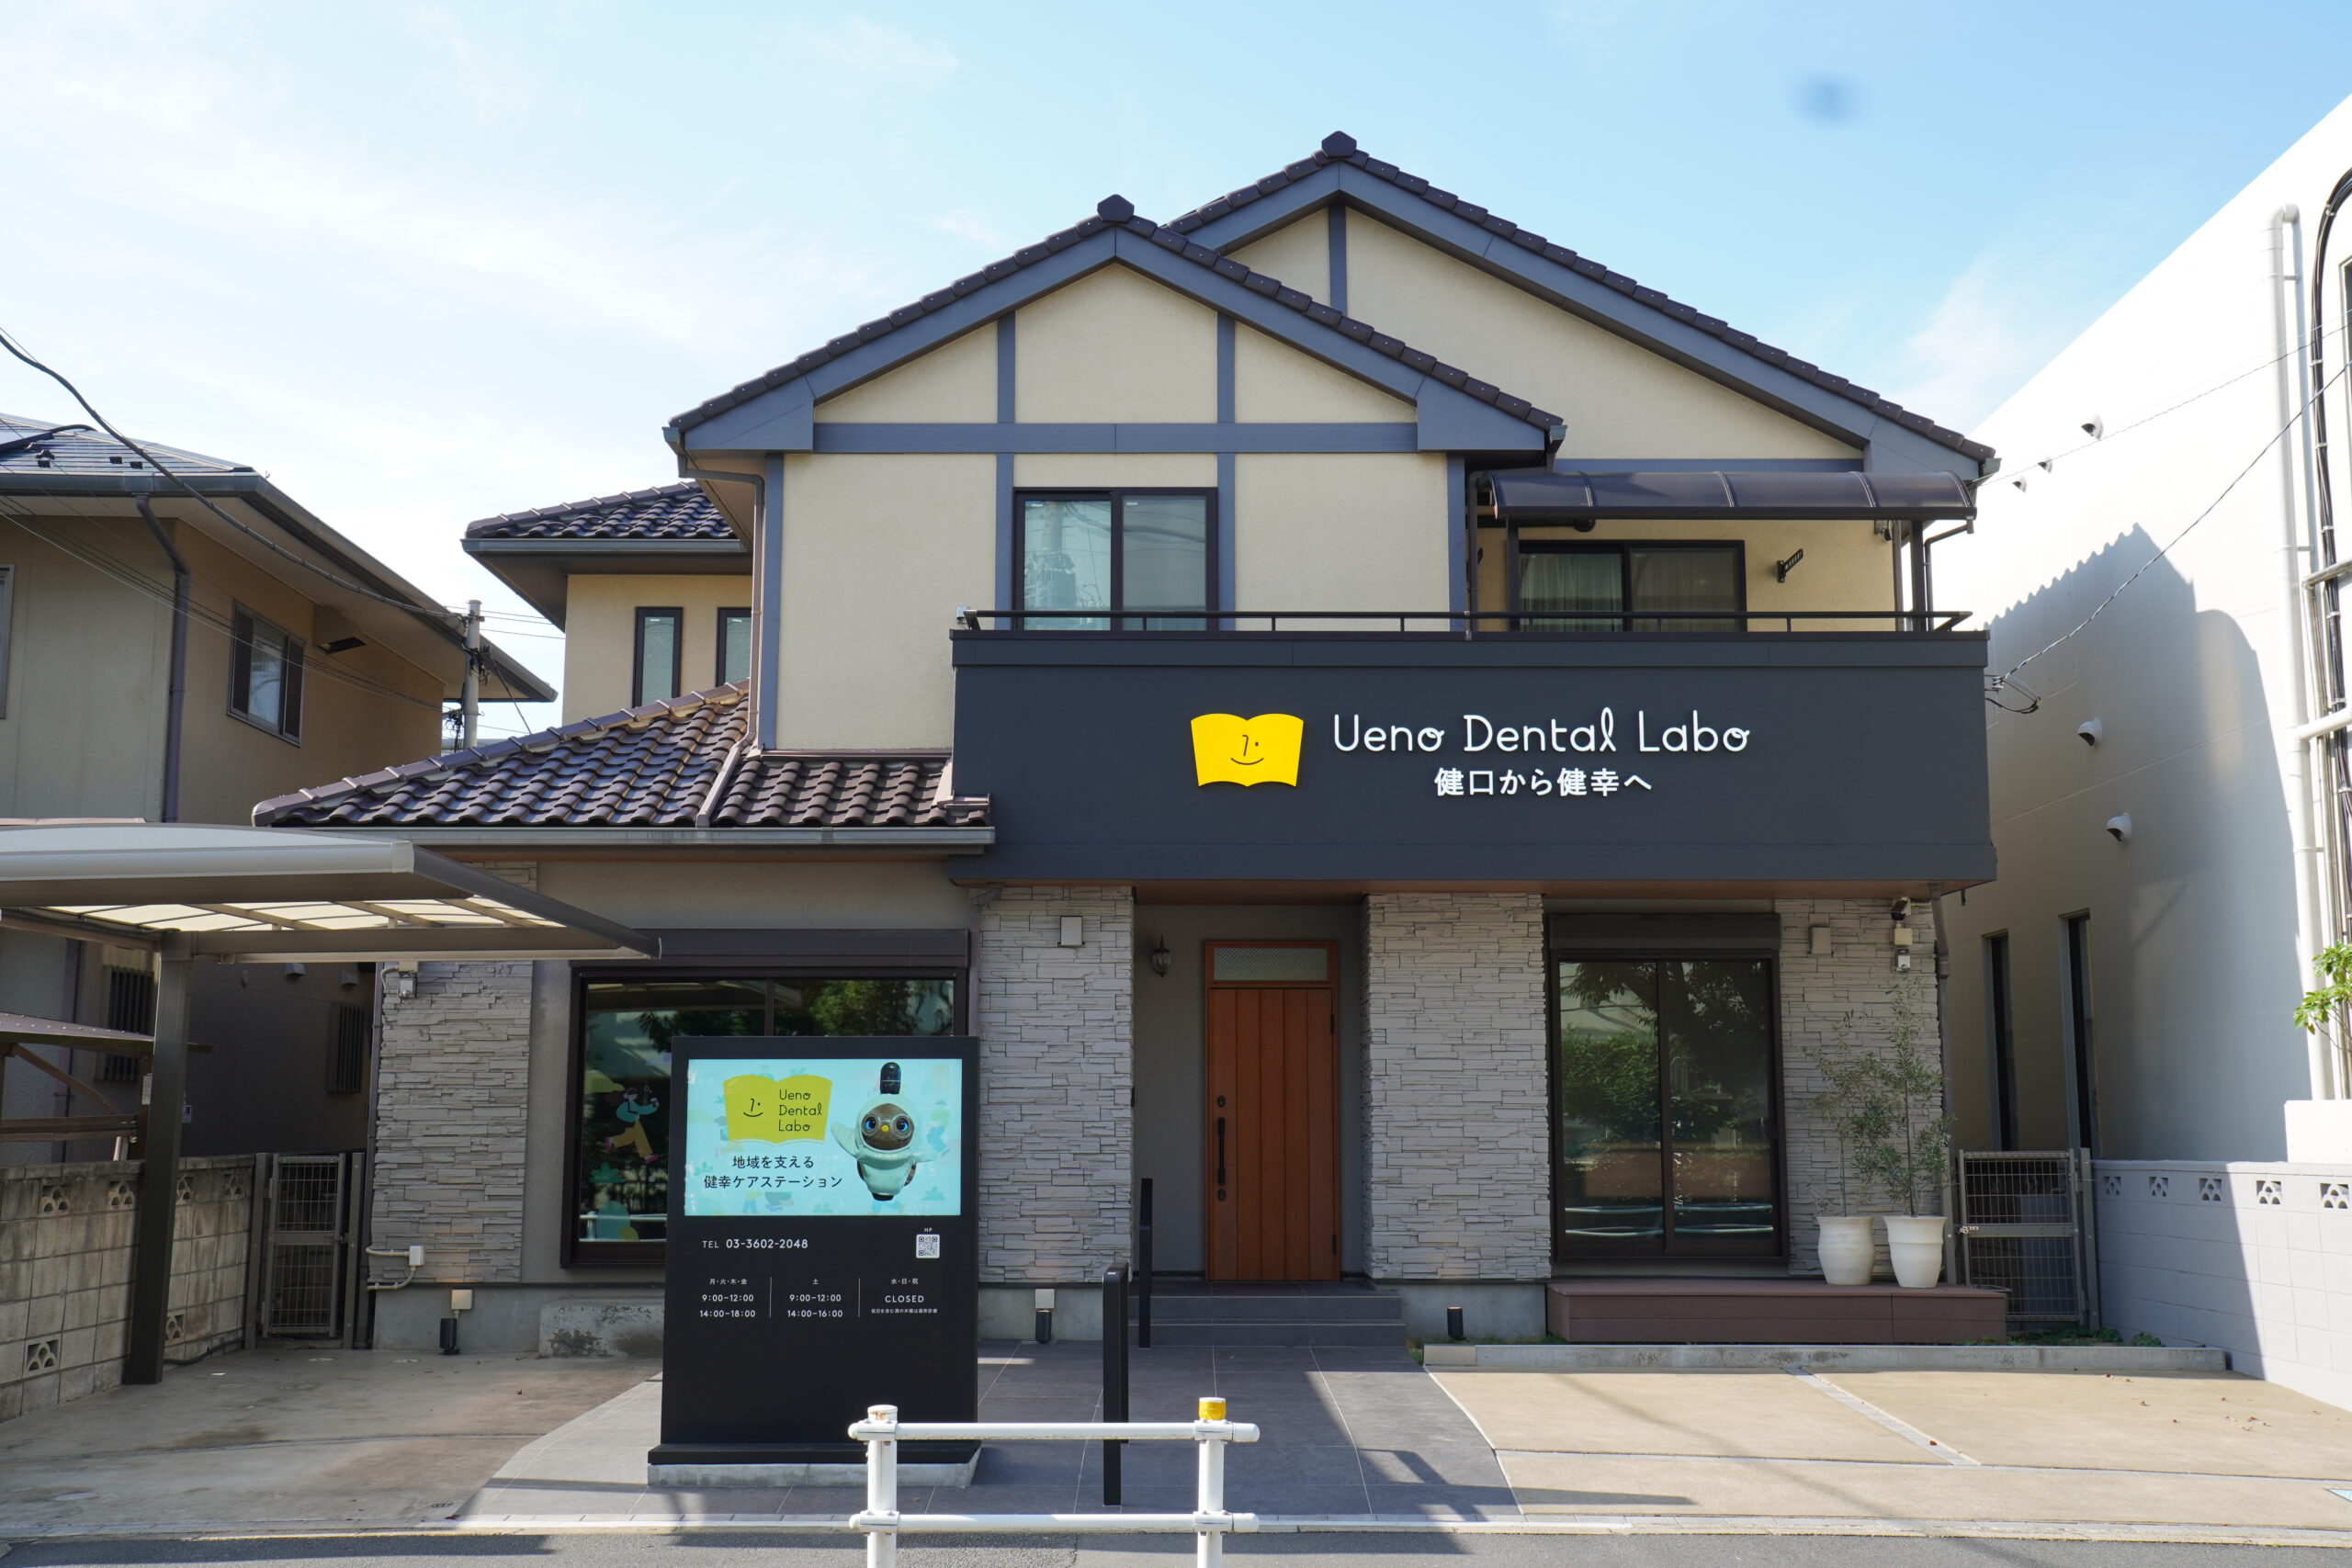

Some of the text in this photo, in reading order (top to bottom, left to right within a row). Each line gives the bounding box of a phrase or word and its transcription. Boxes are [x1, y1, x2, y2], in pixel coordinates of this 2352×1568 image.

[1333, 706, 1751, 753] Ueno Dental Labo
[1433, 766, 1653, 797] 健口から健幸へ
[778, 1089, 811, 1101] Ueno
[778, 1102, 823, 1117] Dental
[778, 1118, 811, 1133] Labo
[731, 1155, 815, 1170] 地域を支える
[703, 1174, 843, 1190] 健幸ケアステーション
[702, 1238, 809, 1250] TEL 03-3602-2048
[701, 1293, 755, 1303] 9:00-12:00
[789, 1293, 842, 1303] 9:00-12:00
[884, 1294, 925, 1303] CLOSED
[699, 1309, 756, 1318] 14:00-18:00
[786, 1309, 843, 1318] 14:00-16:00
